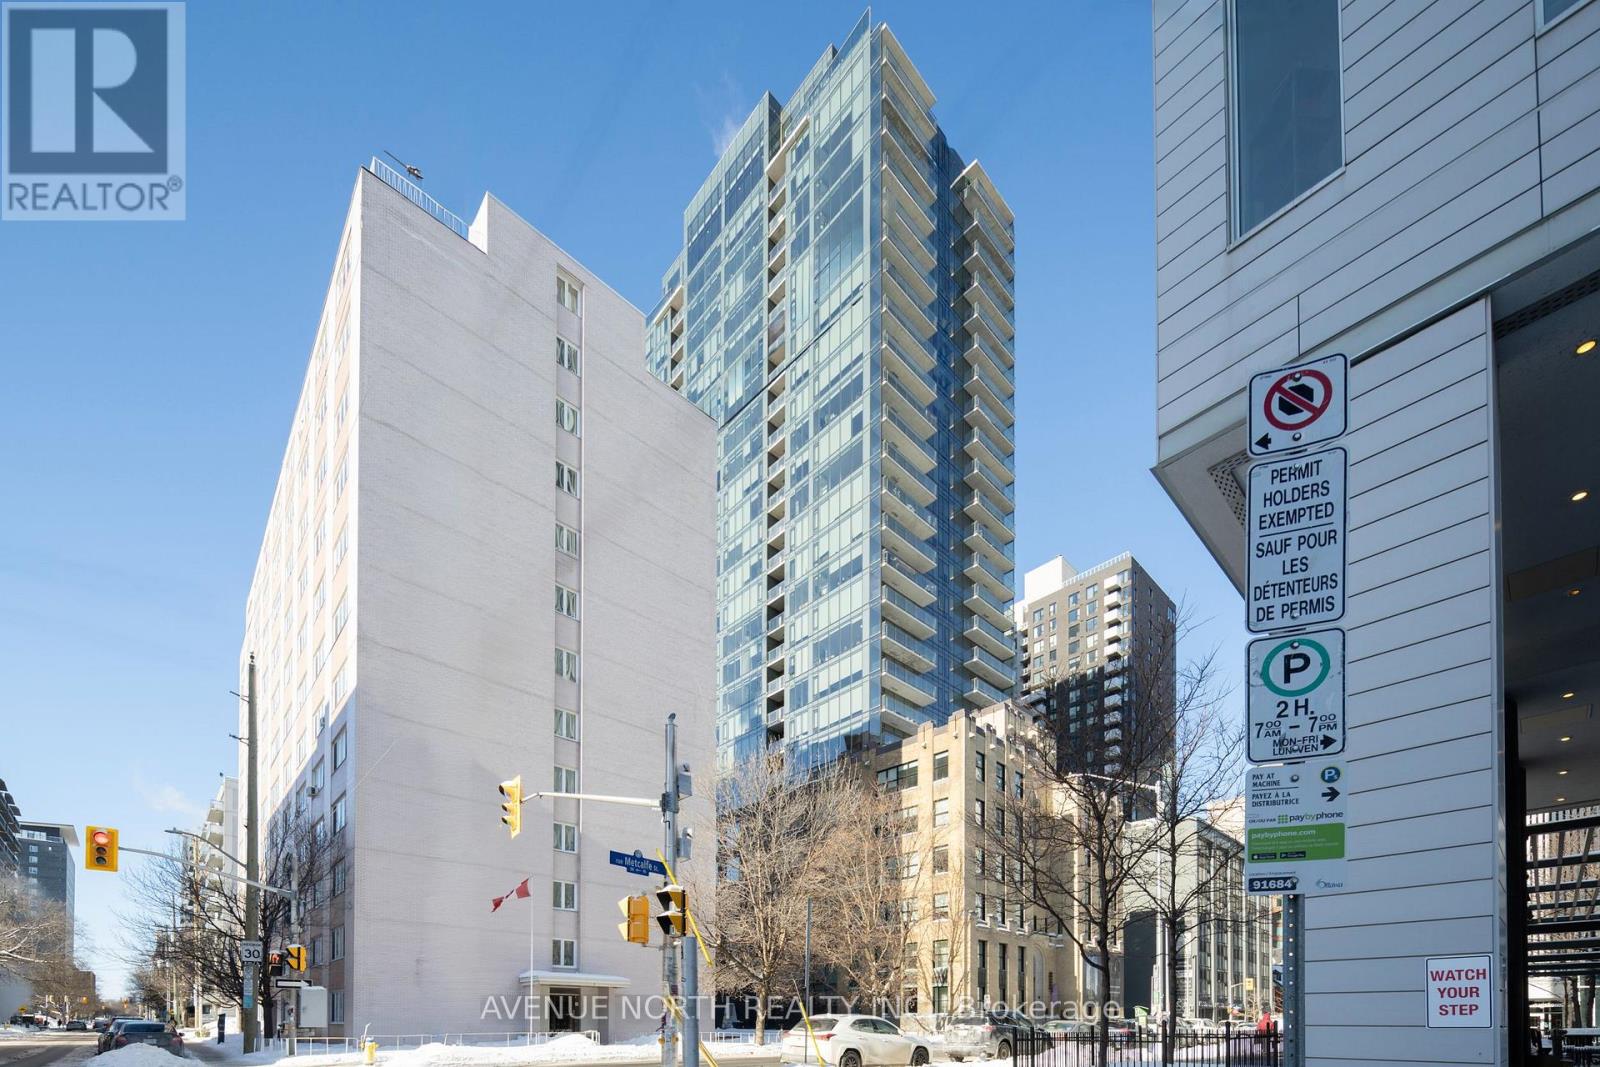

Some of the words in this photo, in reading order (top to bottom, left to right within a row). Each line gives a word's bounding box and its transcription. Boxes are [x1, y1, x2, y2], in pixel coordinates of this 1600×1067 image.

[1271, 460, 1323, 485] PERMIT
[1264, 480, 1330, 508] HOLDERS
[1259, 502, 1334, 530] EXEMPTED
[1256, 538, 1292, 558] SAUF
[1298, 530, 1337, 551] POUR
[1282, 556, 1308, 575] LES
[1254, 572, 1338, 602] DÉTENTEURS
[1256, 606, 1274, 622] DE
[1282, 596, 1335, 619] PERMIS
[1284, 652, 1310, 684] P
[1276, 700, 1288, 718] 2
[1294, 698, 1314, 716] H.
[1264, 730, 1281, 738] AM
[1319, 723, 1337, 732] PM
[1272, 736, 1318, 748] MON-FRI
[1272, 744, 1318, 756] LUNVEN
[1252, 798, 1299, 808] DISTRIBUTRICE
[1289, 812, 1344, 822] paybyphone
[1252, 830, 1316, 840] paybyphone.com
[625, 856, 652, 870] Metcalfe
[1253, 879, 1292, 890] 91684
[244, 949, 260, 959] 30
[1430, 968, 1486, 981] WATCH
[1438, 986, 1480, 998] YOUR
[1439, 1004, 1479, 1016] STEP
